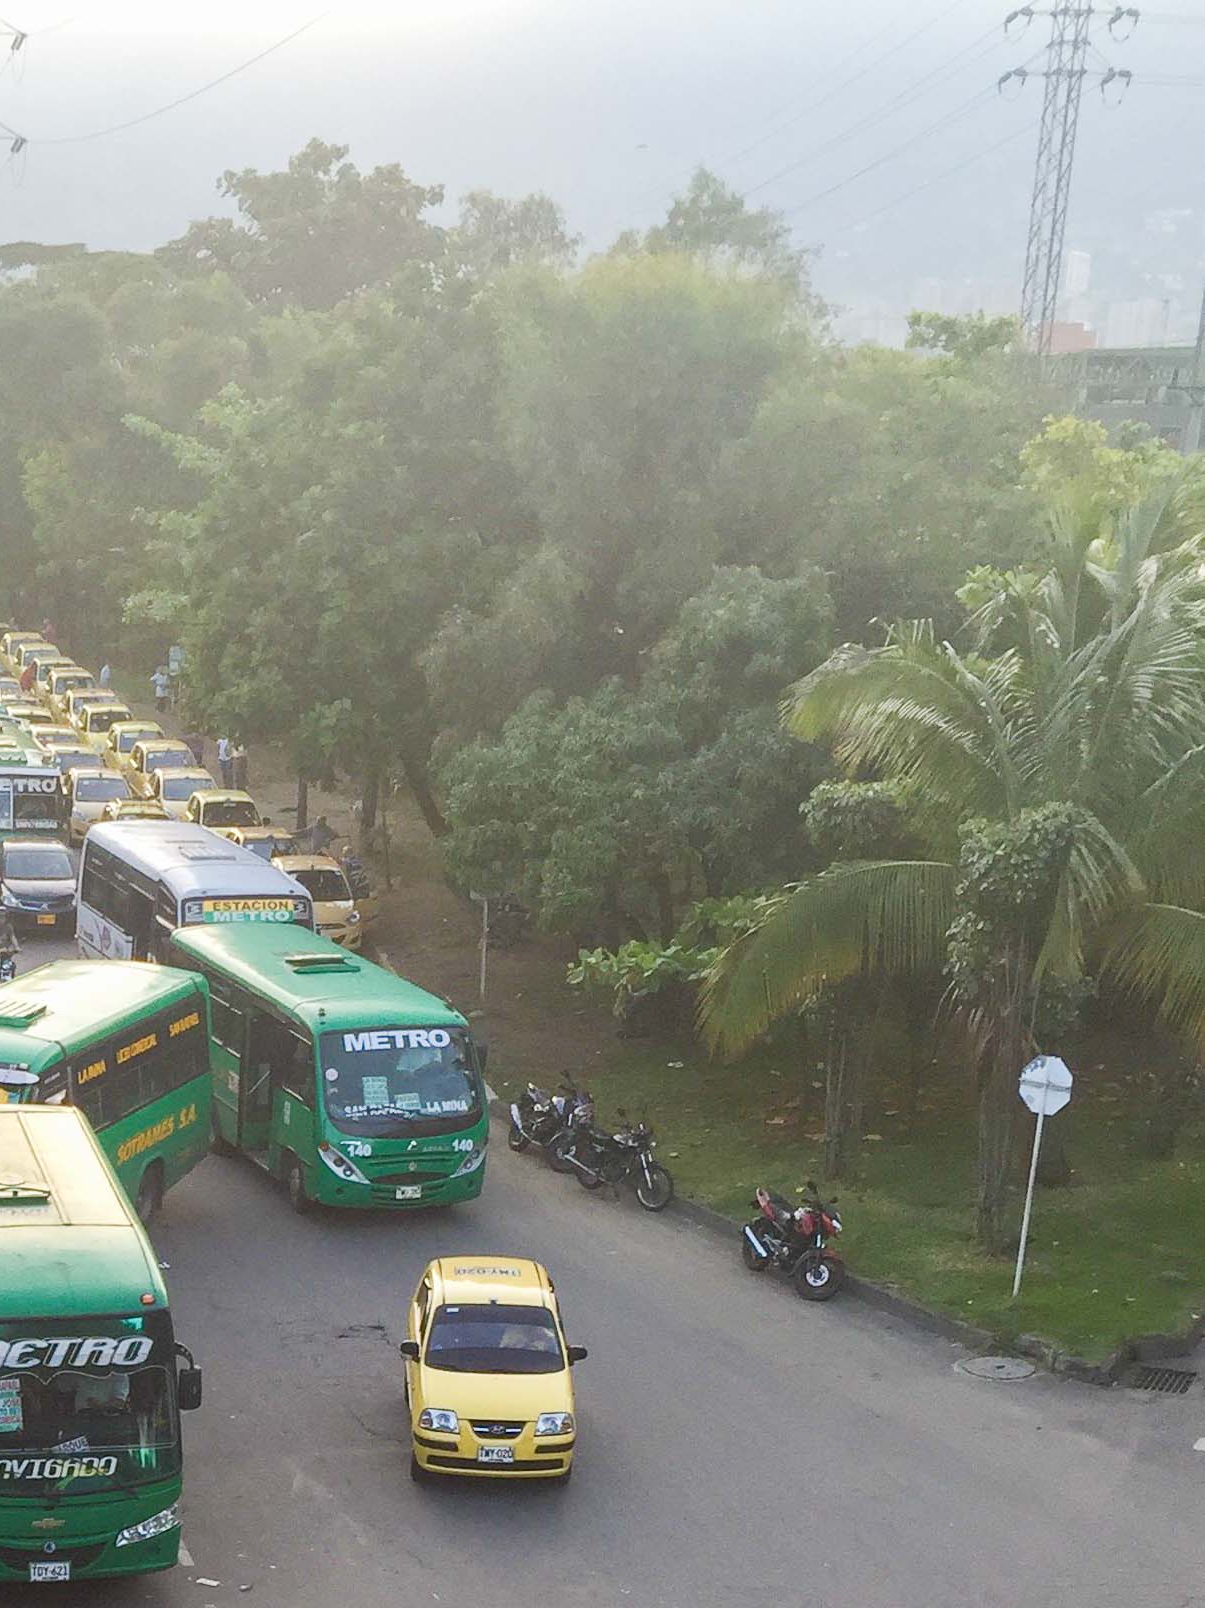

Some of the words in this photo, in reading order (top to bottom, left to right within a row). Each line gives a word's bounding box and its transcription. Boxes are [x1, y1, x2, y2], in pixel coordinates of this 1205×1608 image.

[213, 901, 288, 912] ESTACION
[213, 912, 290, 922] METRO
[343, 1029, 451, 1052] METRO
[348, 1144, 372, 1157] 140
[452, 1139, 473, 1151] 140
